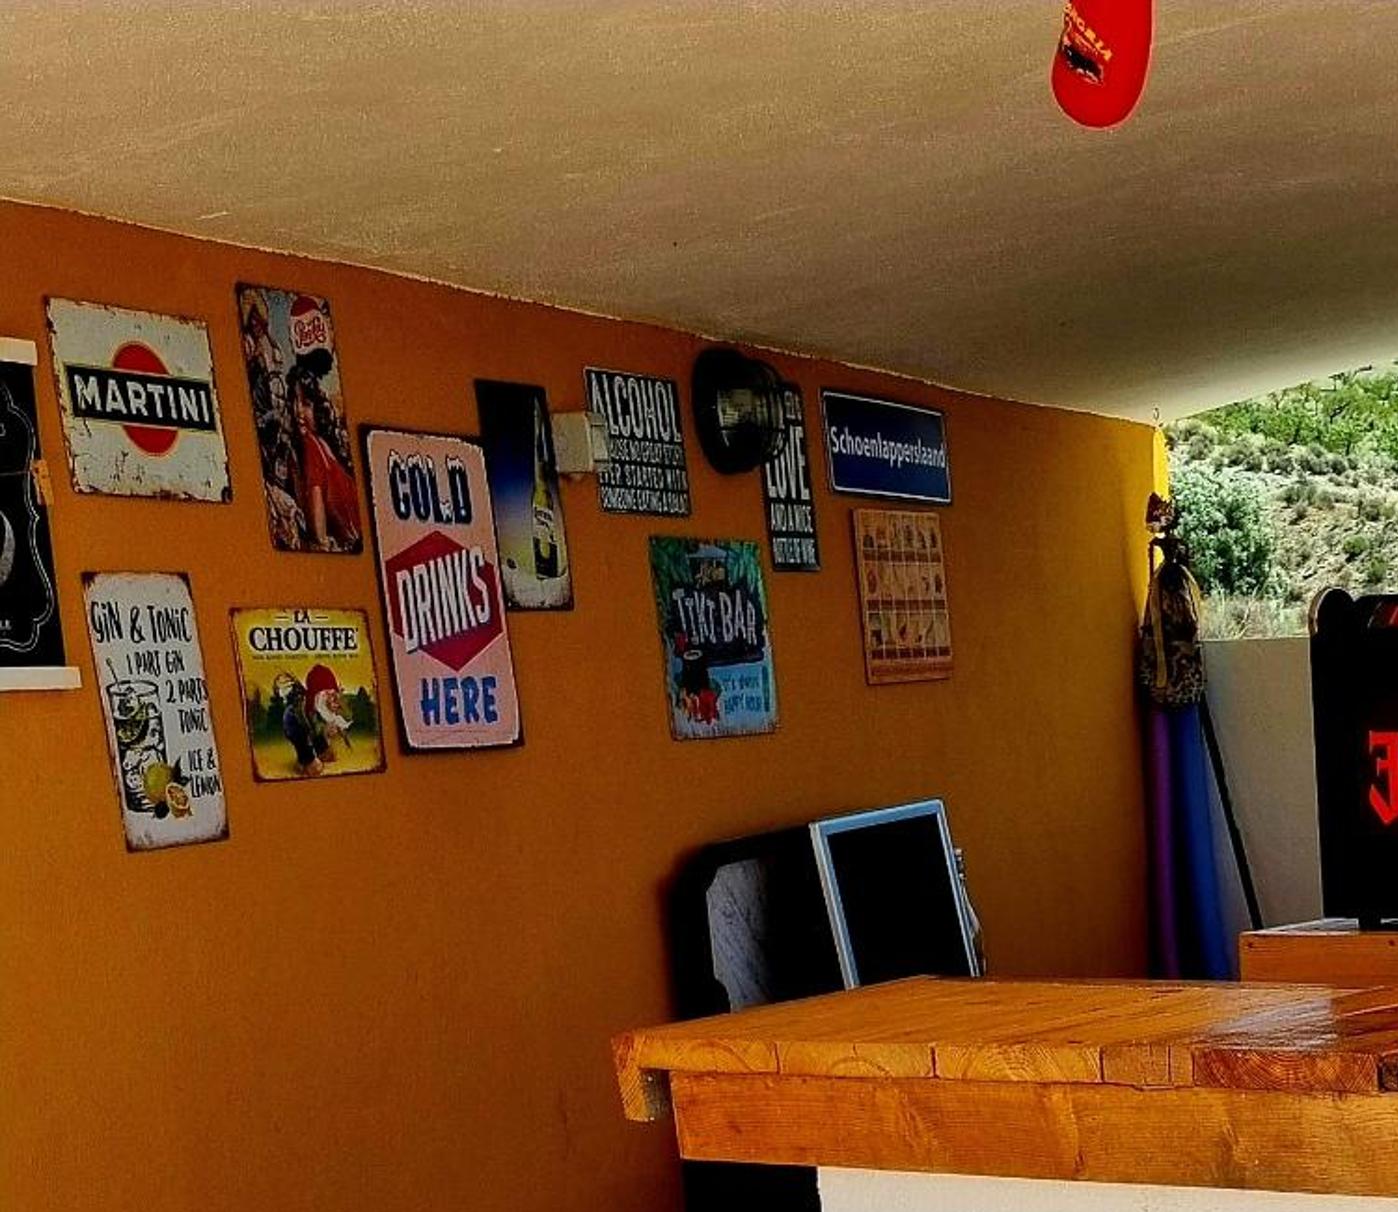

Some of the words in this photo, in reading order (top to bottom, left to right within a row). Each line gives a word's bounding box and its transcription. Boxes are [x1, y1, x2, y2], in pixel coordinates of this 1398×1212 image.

[74, 374, 211, 424] MARTINI
[590, 371, 683, 443] ALCOHOL
[388, 450, 473, 526] COLD
[293, 610, 311, 624] LA
[396, 546, 491, 655] DRINKS
[672, 588, 716, 646] TIKI
[719, 589, 758, 646] BAR
[130, 606, 145, 643] &
[249, 627, 356, 652] CHOUFFE
[126, 655, 132, 675] 1
[135, 651, 160, 678] PART
[166, 680, 177, 703] 2
[178, 678, 209, 704] PARTS
[420, 676, 498, 726] HERE
[190, 774, 221, 798] LEMON
